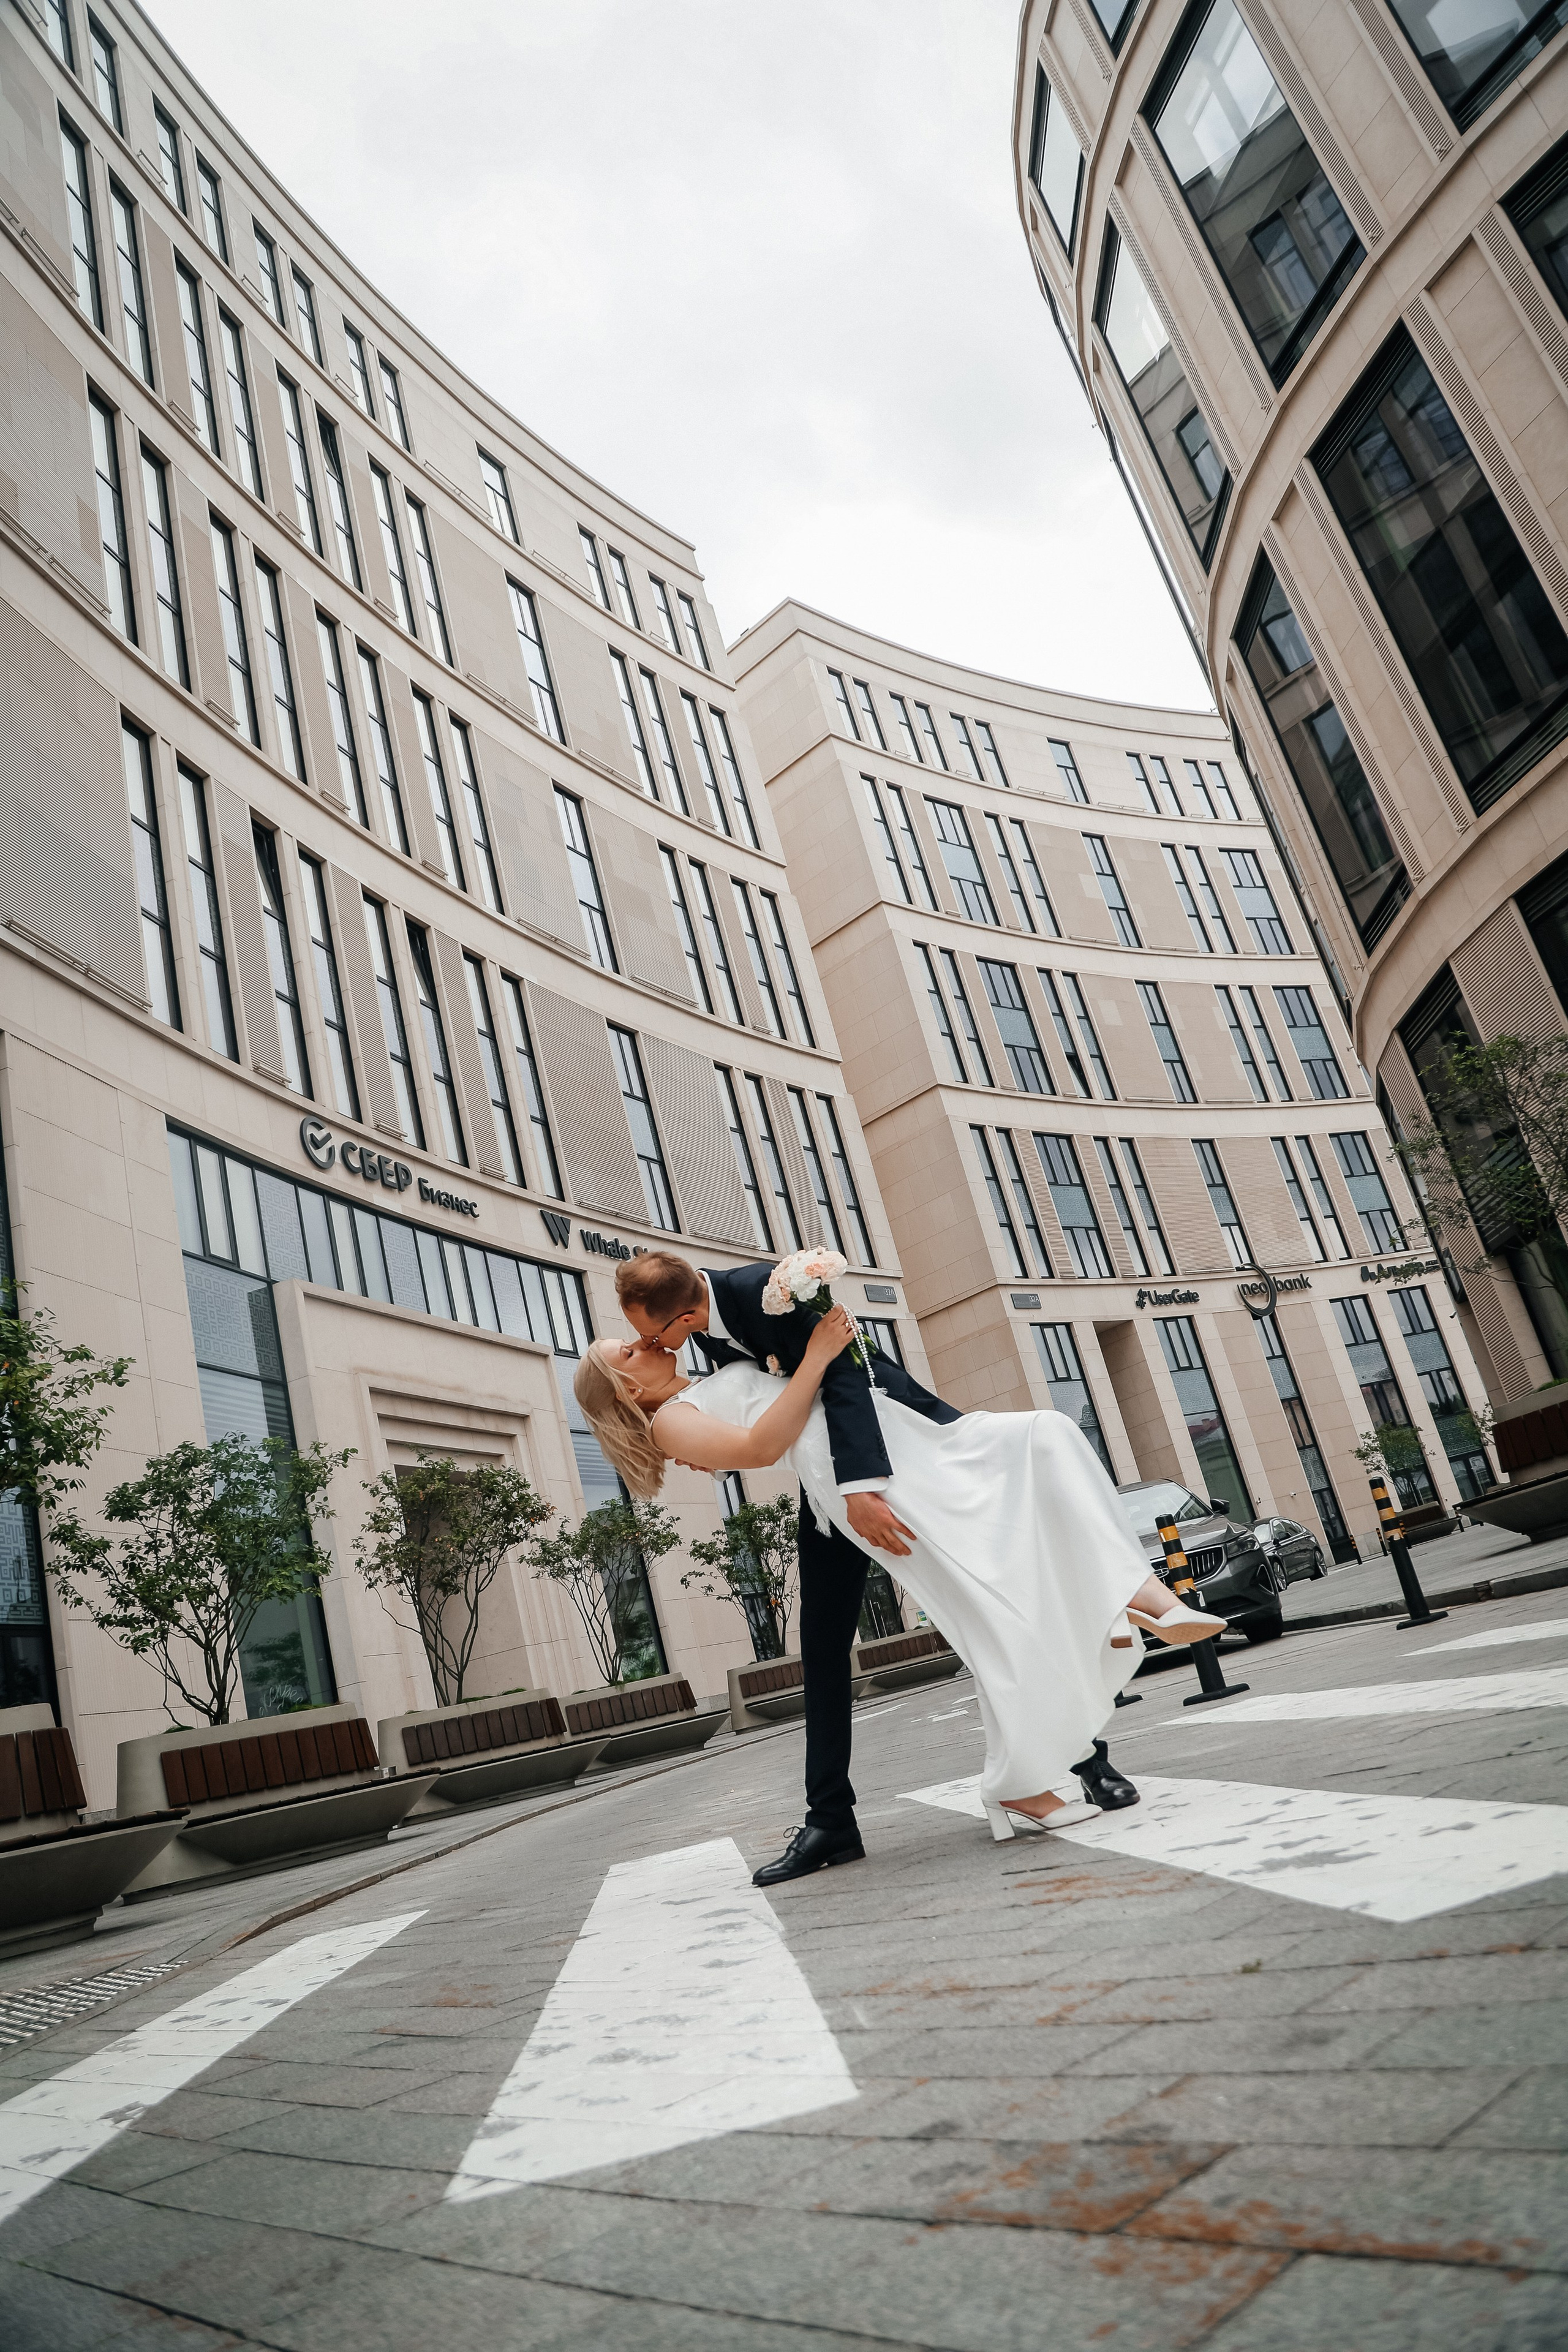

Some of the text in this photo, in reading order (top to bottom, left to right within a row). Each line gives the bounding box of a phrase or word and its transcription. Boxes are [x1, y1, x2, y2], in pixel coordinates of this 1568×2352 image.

[341, 1140, 480, 1218] СБЕР Бизнес
[579, 1229, 631, 1261] Whale
[1147, 1288, 1200, 1305] UserGate
